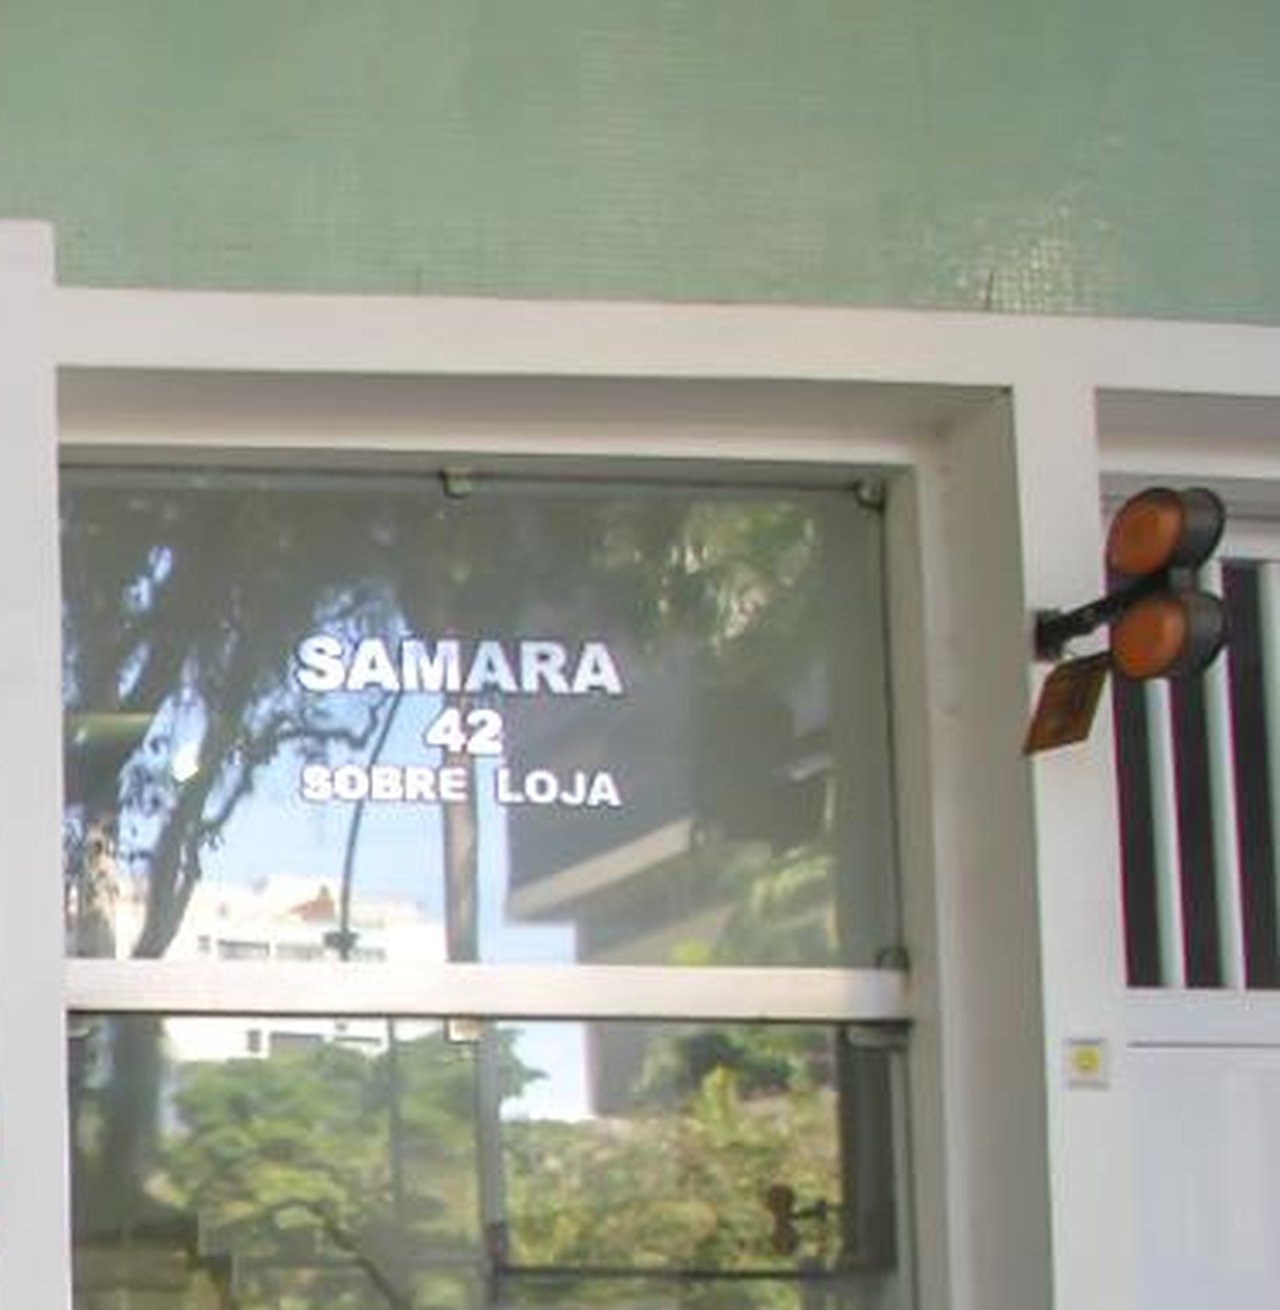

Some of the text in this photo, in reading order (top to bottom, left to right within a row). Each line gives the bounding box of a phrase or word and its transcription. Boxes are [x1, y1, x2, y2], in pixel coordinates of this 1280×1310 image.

[297, 634, 622, 694] SAMARA
[425, 708, 503, 754] 42
[301, 765, 622, 806] SOBRE LOJA
